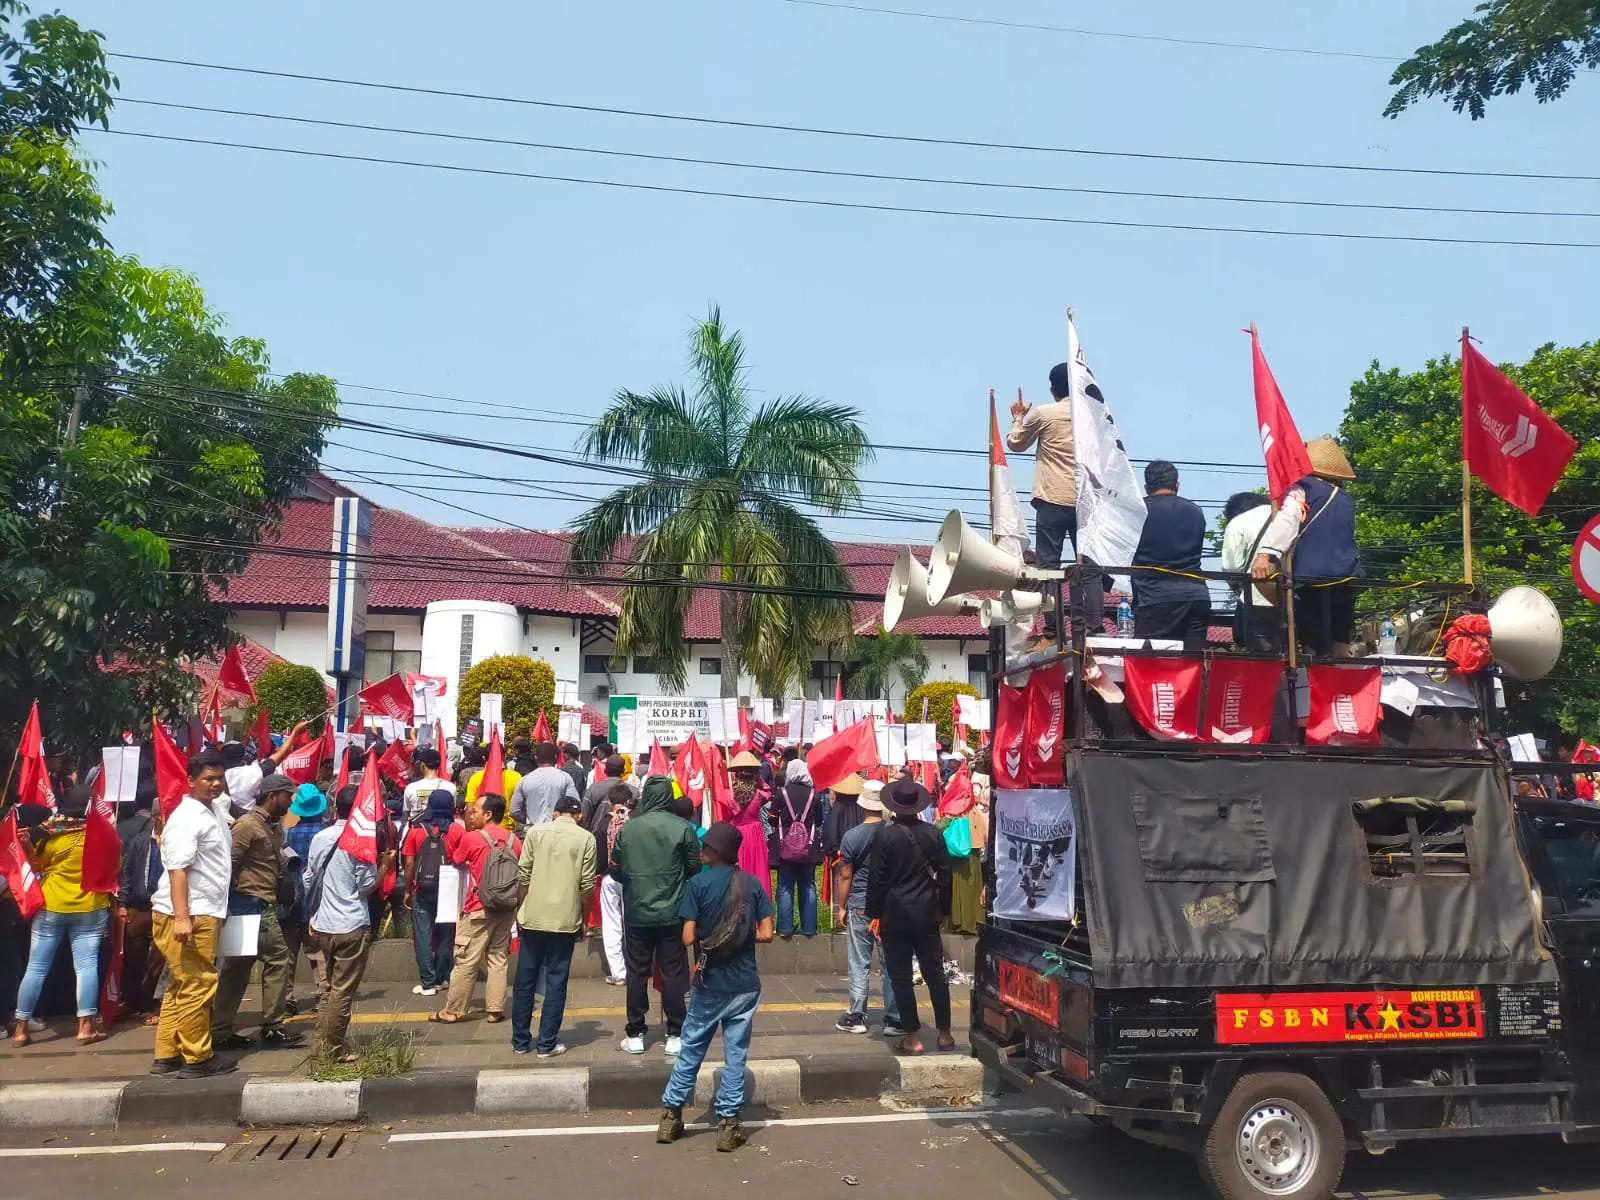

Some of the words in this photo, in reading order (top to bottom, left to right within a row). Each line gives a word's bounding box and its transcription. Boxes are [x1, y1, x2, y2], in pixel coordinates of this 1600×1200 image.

[1411, 990, 1474, 1002] KONFEDERASI
[1120, 1028, 1155, 1037] MEGA
[1157, 1028, 1199, 1037] CARRY
[1344, 1032, 1373, 1041] Kongres
[1398, 1030, 1423, 1039] Serikat
[1424, 1030, 1444, 1038] Buruh
[1445, 1029, 1478, 1038] Indonesia
